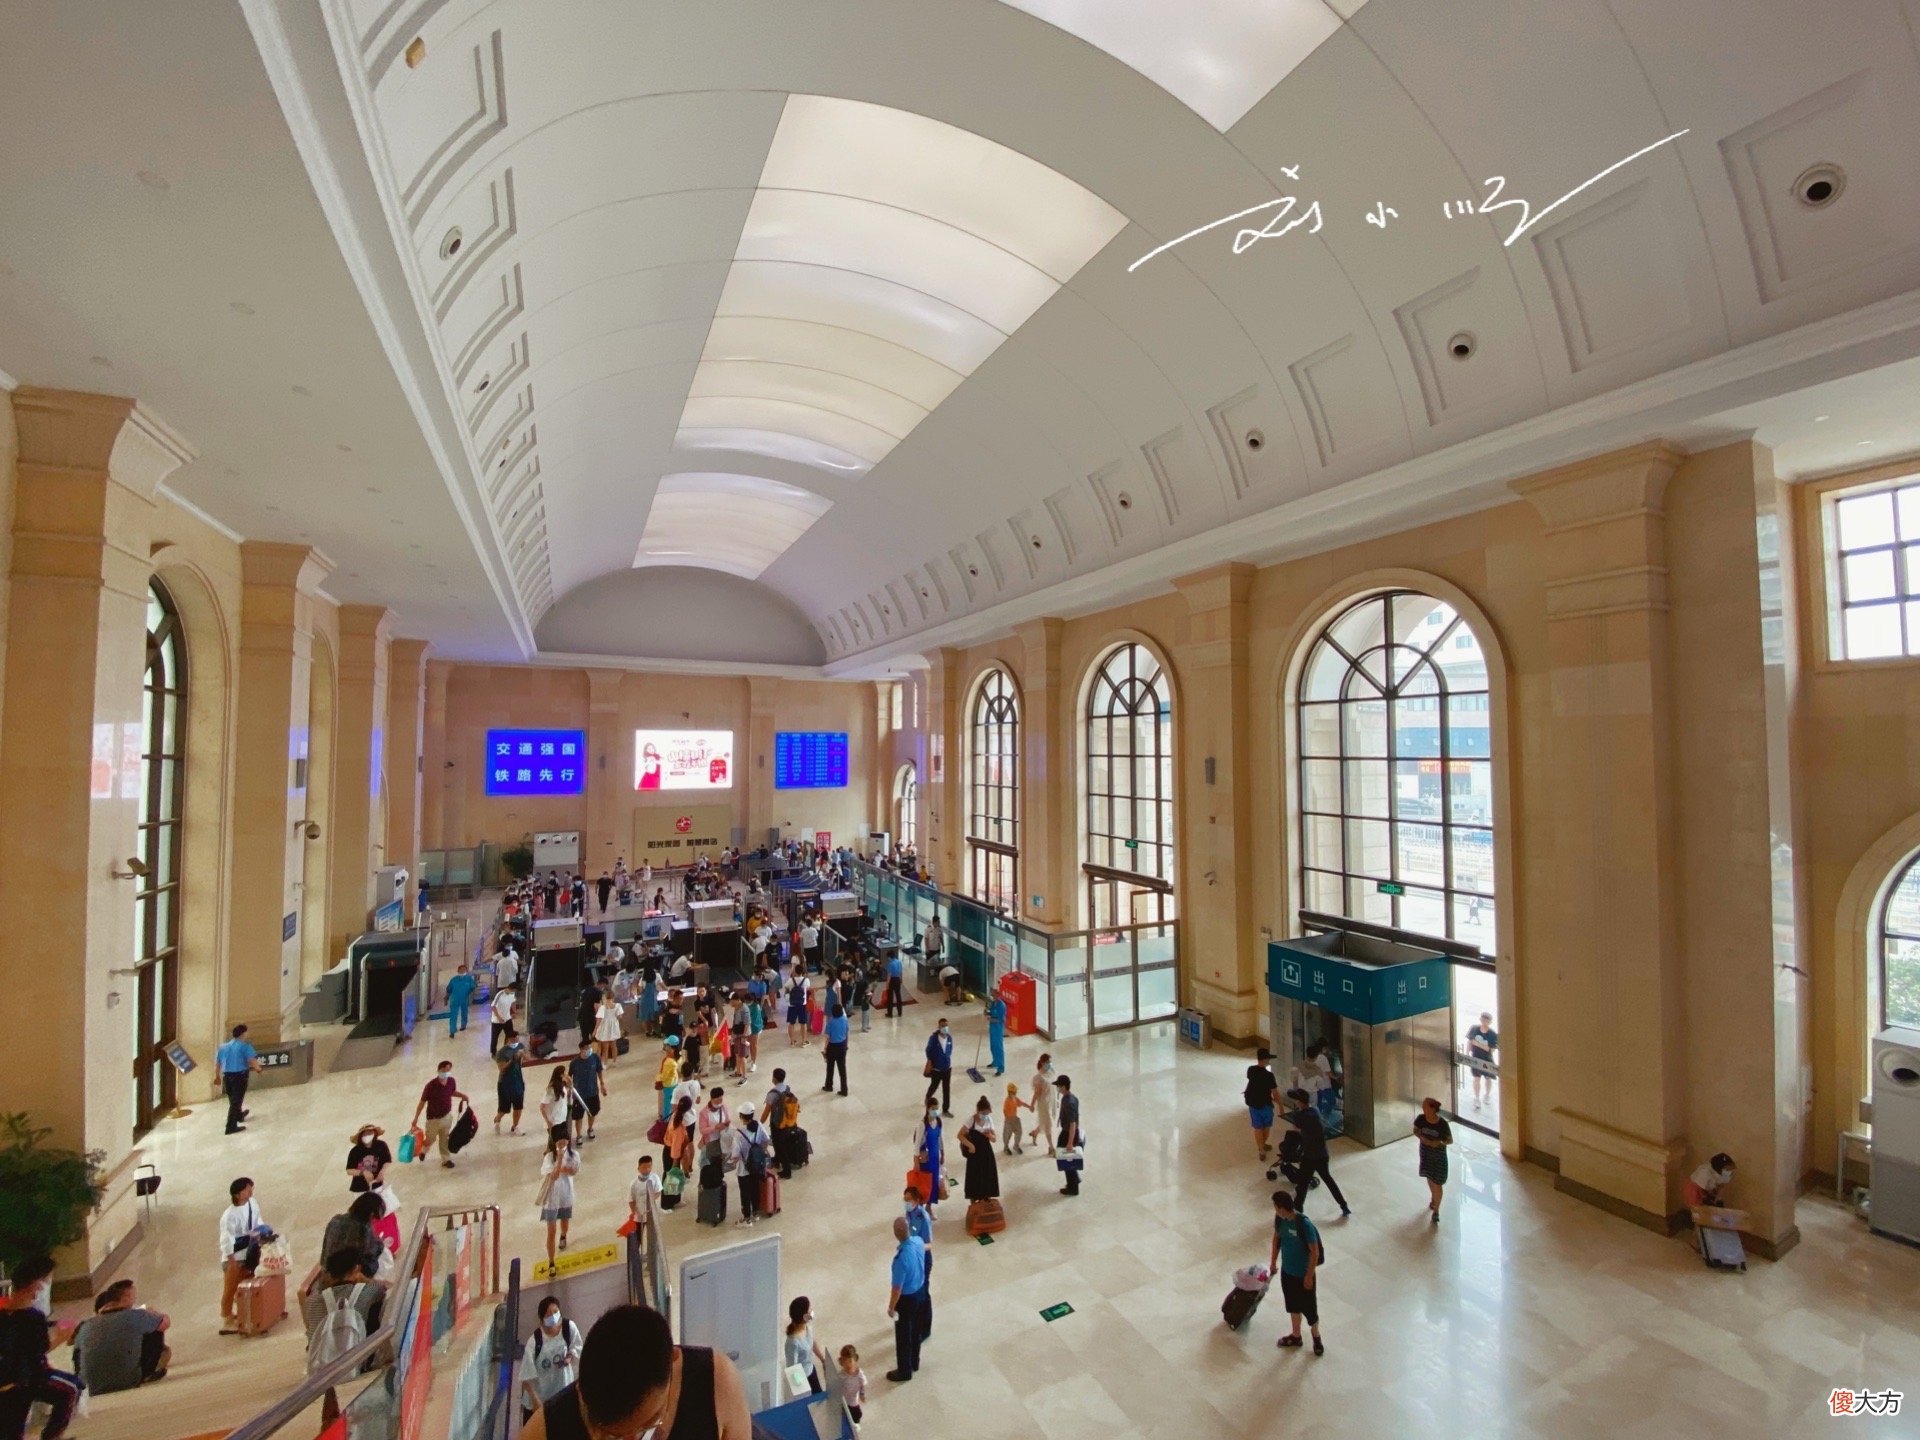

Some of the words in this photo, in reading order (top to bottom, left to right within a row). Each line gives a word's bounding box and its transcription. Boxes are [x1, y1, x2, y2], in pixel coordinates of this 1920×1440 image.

[496, 742, 576, 755] 交通强国
[494, 768, 575, 782] 铁路先行
[1313, 970, 1353, 995] 出口
[1397, 976, 1427, 995] 出口
[1314, 986, 1325, 995] Exit
